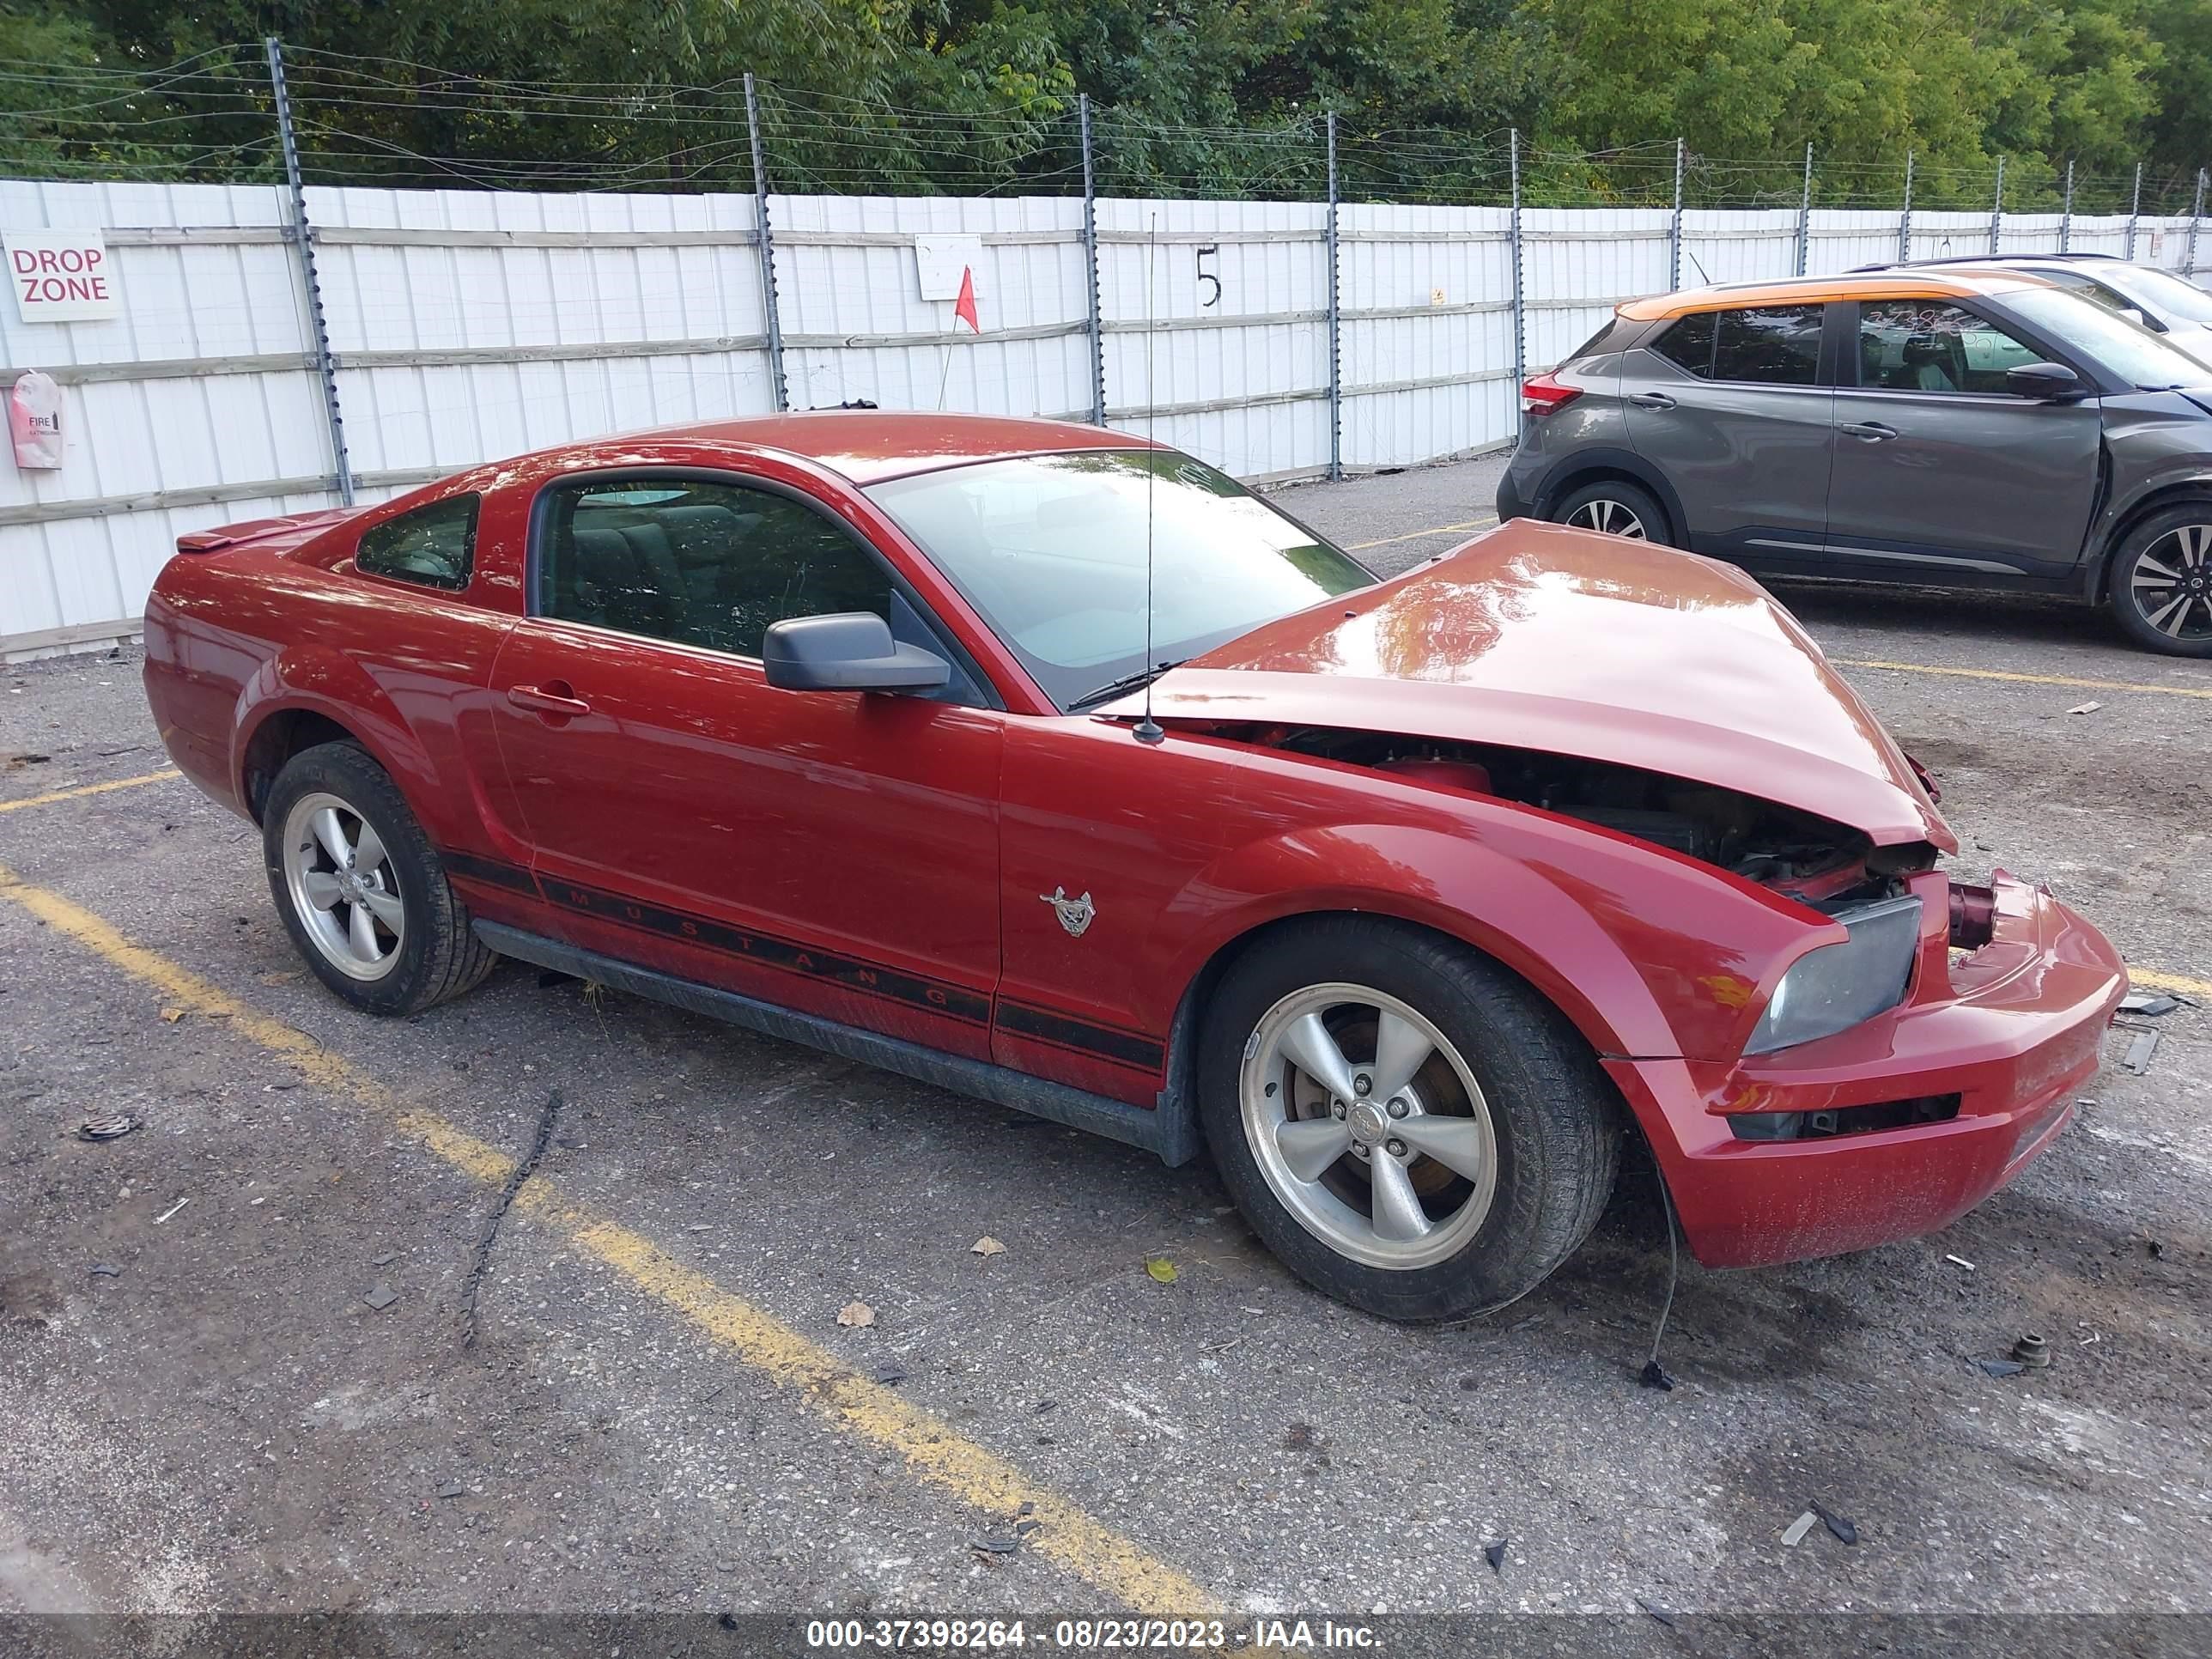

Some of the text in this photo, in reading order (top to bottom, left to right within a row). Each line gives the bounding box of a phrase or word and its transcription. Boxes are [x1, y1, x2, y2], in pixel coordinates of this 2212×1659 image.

[13, 249, 101, 274] DROP
[1197, 244, 1221, 307] 5
[21, 277, 109, 302] ZONE
[29, 416, 51, 427] FIRE
